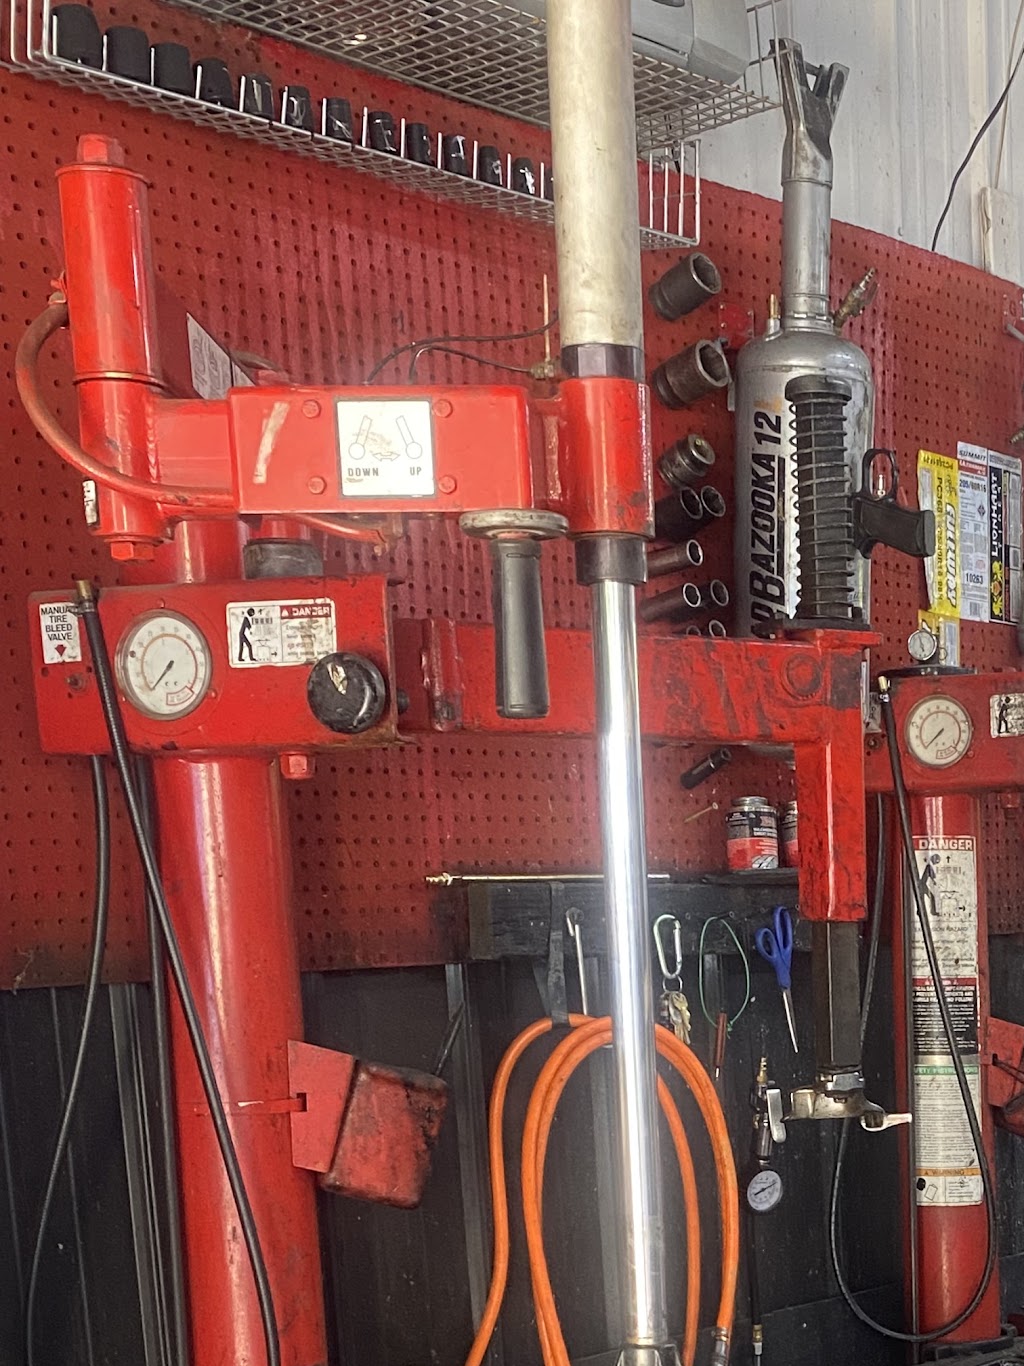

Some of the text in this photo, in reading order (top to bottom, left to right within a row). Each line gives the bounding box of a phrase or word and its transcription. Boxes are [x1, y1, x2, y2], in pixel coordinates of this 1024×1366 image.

[958, 449, 987, 462] SUMMIT
[347, 466, 422, 477] DOWN UP
[49, 615, 68, 623] TIRE
[45, 624, 73, 633] BLEED
[48, 632, 73, 641] VALVE
[919, 839, 973, 851] DANGER
